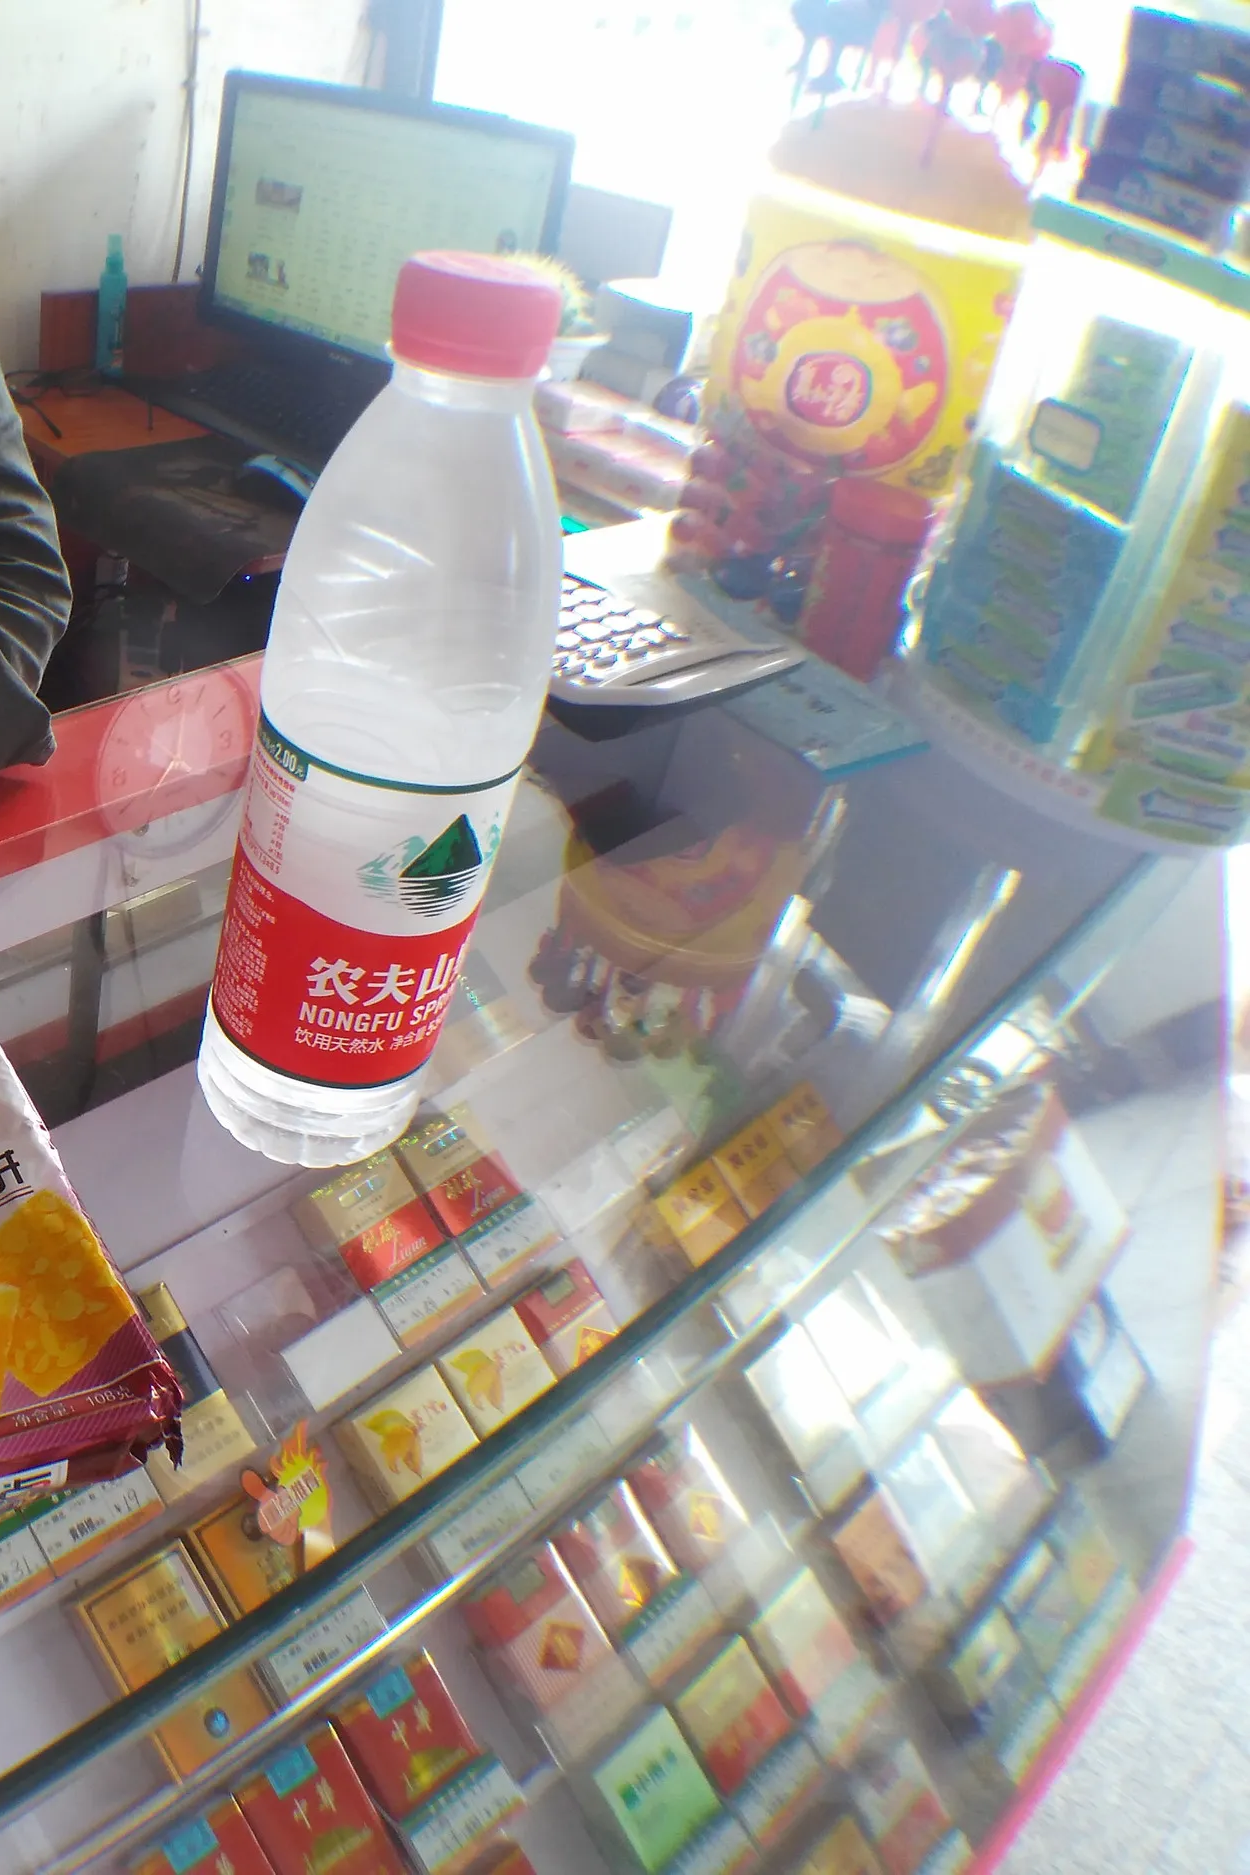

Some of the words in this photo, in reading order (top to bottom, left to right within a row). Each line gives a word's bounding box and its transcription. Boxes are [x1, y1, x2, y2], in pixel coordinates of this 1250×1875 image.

[306, 948, 464, 1006] 农夫山
[299, 1001, 404, 1033] NONGFU
[409, 986, 453, 1026] SPR
[295, 1026, 386, 1055] 饮用天然水
